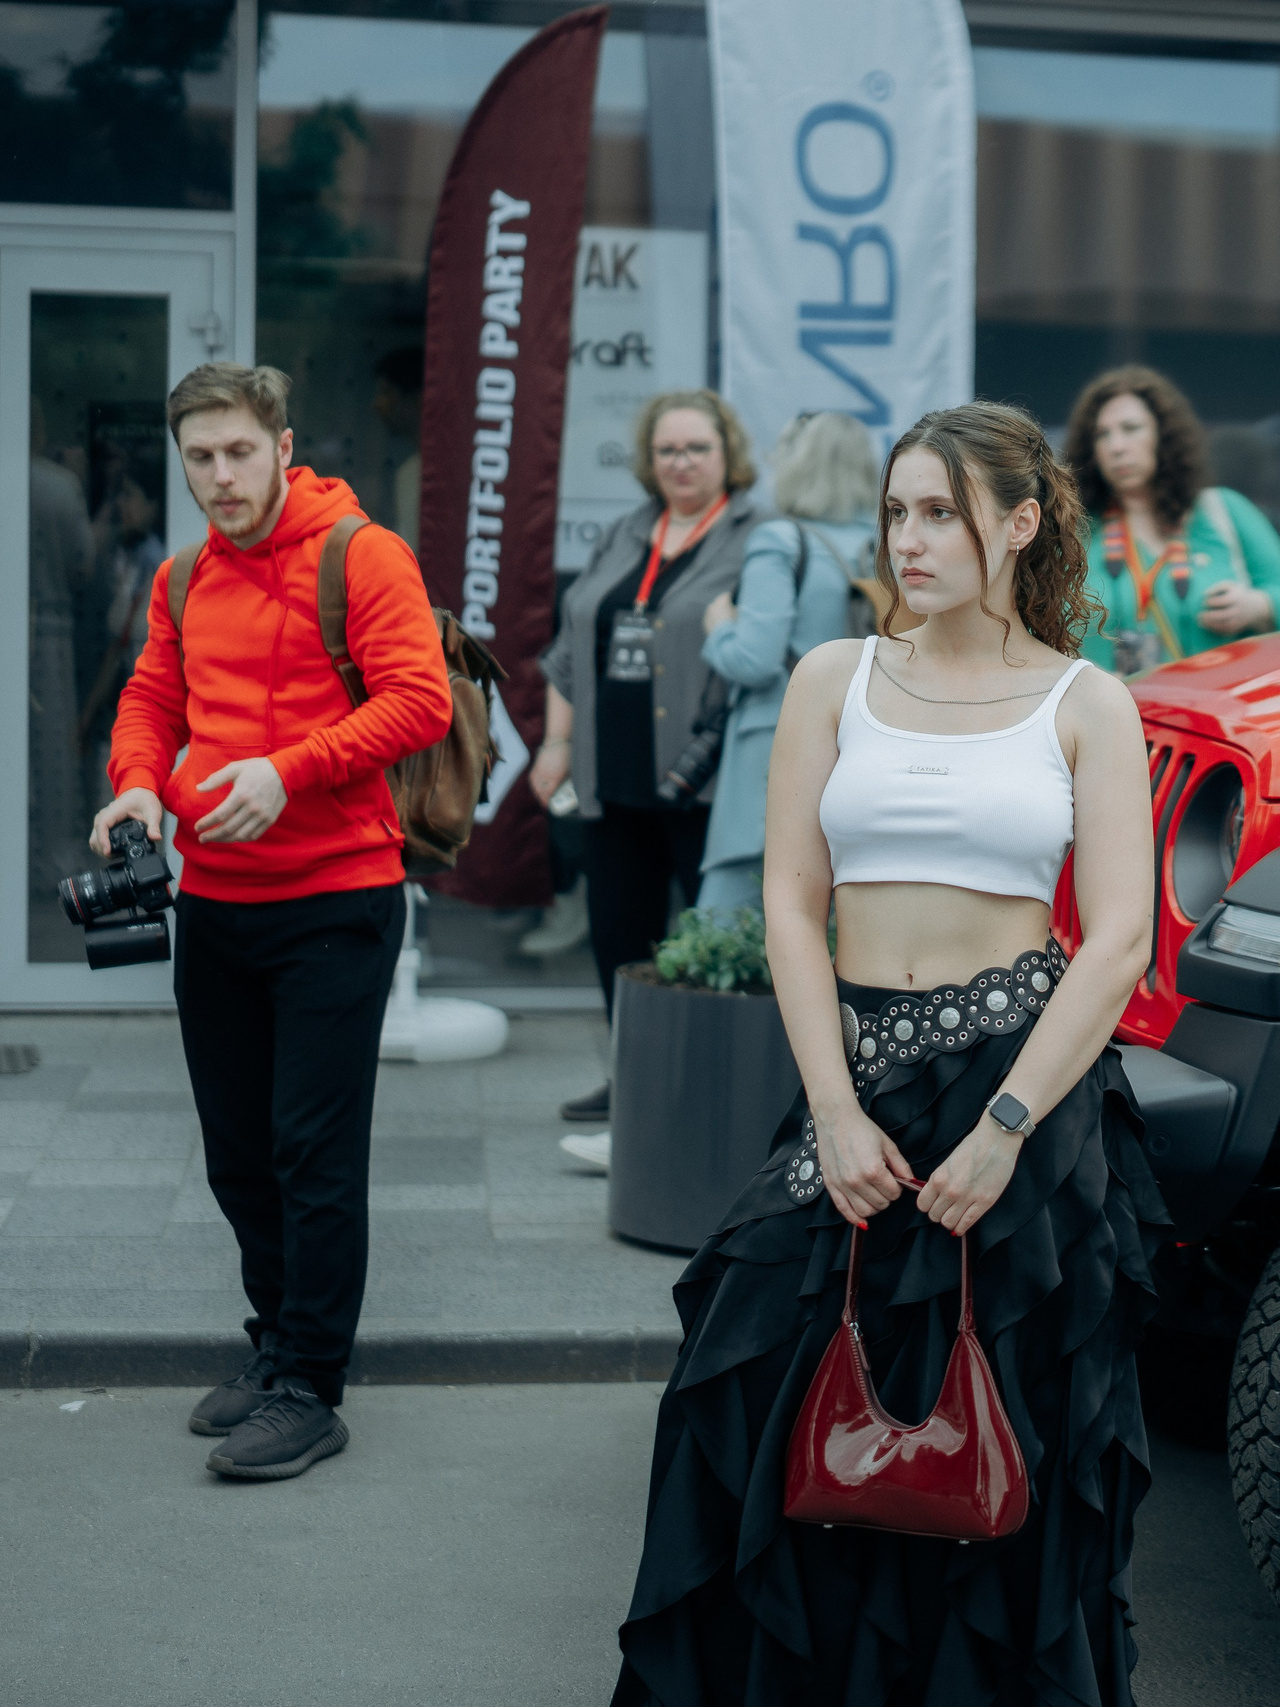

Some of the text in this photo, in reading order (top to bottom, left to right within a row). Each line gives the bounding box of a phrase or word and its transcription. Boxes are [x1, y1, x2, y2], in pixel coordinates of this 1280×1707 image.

[461, 188, 531, 641] PORTFOLIO PARTY
[571, 331, 654, 367] raft
